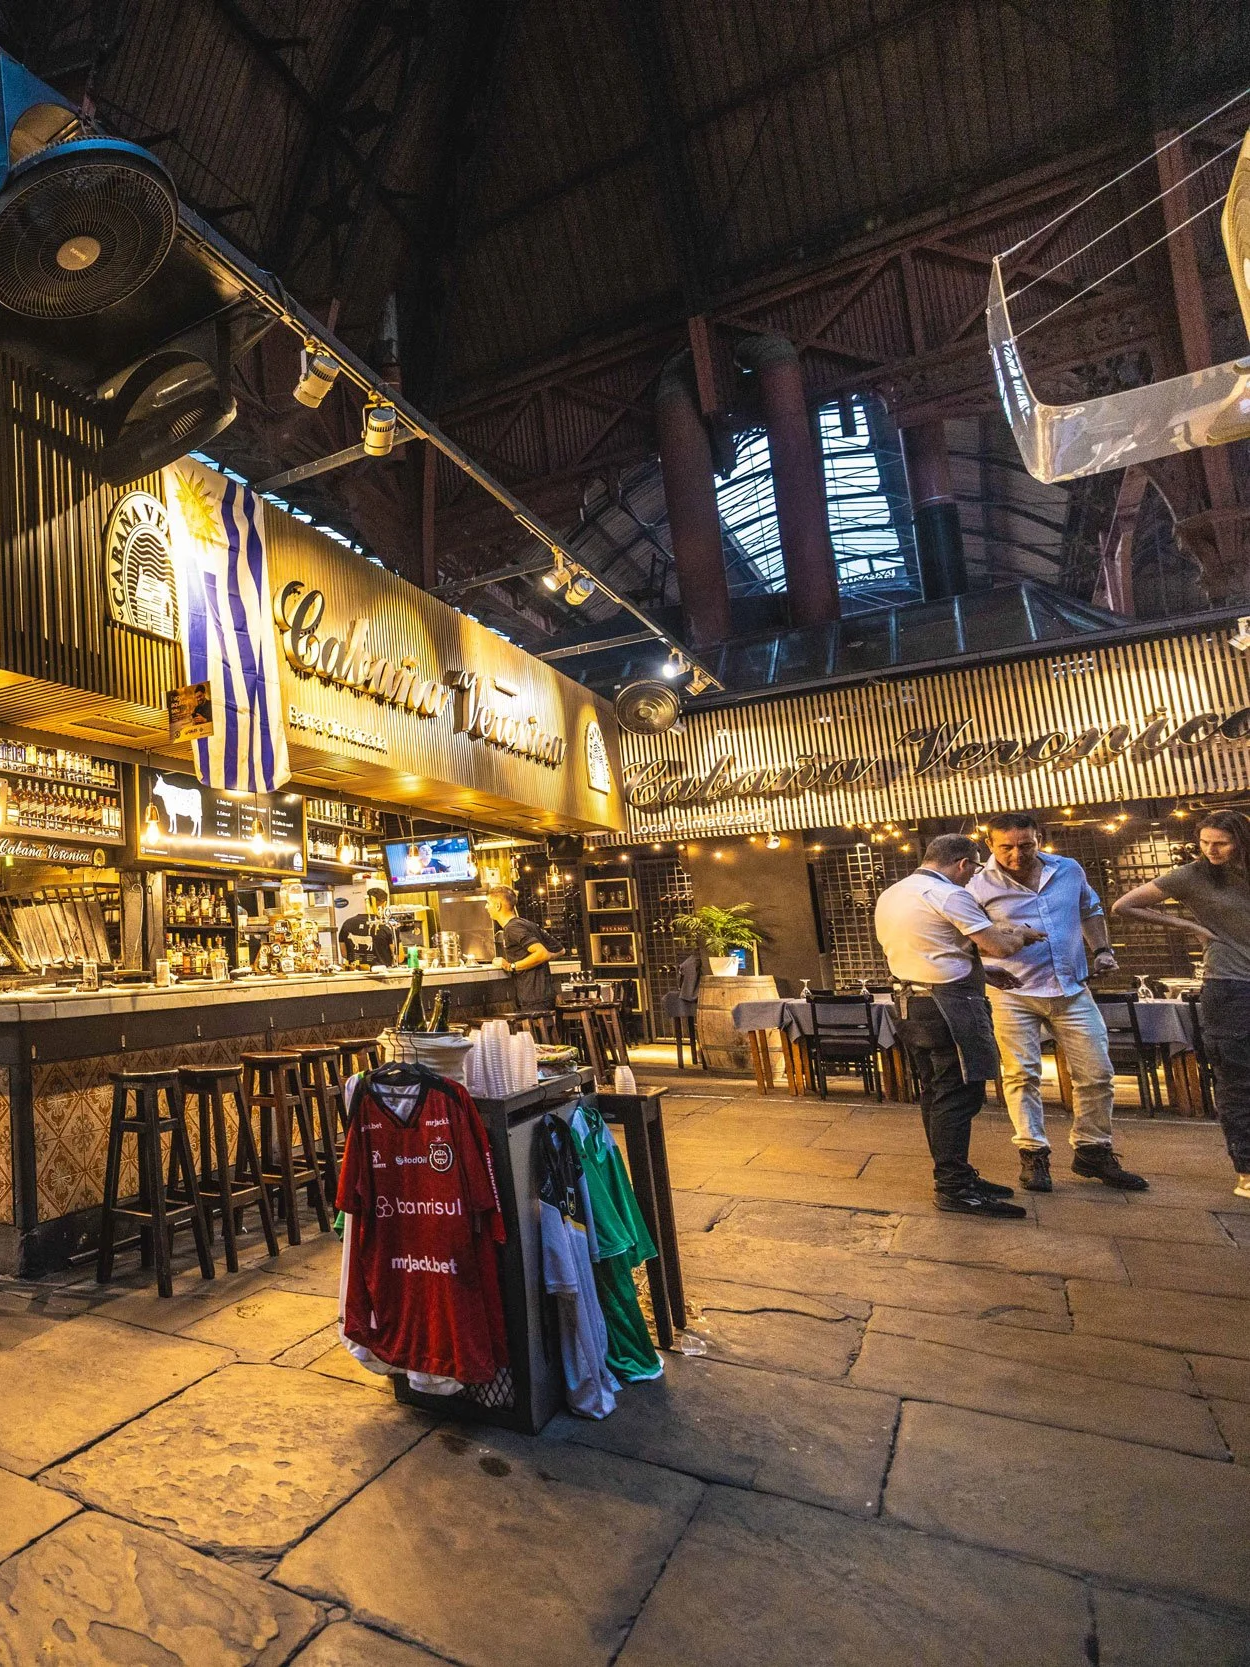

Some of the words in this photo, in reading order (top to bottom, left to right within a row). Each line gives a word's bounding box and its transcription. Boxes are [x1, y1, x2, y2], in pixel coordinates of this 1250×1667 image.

[111, 505, 142, 608] CABAÑA
[273, 580, 450, 718] Cabaña
[444, 669, 568, 766] Veronica
[289, 704, 323, 734] Barra
[622, 750, 880, 806] Cabaña
[631, 819, 671, 835] Local
[674, 812, 766, 831] climatizado
[46, 844, 91, 862] Veronica
[396, 1197, 462, 1216] banrisul
